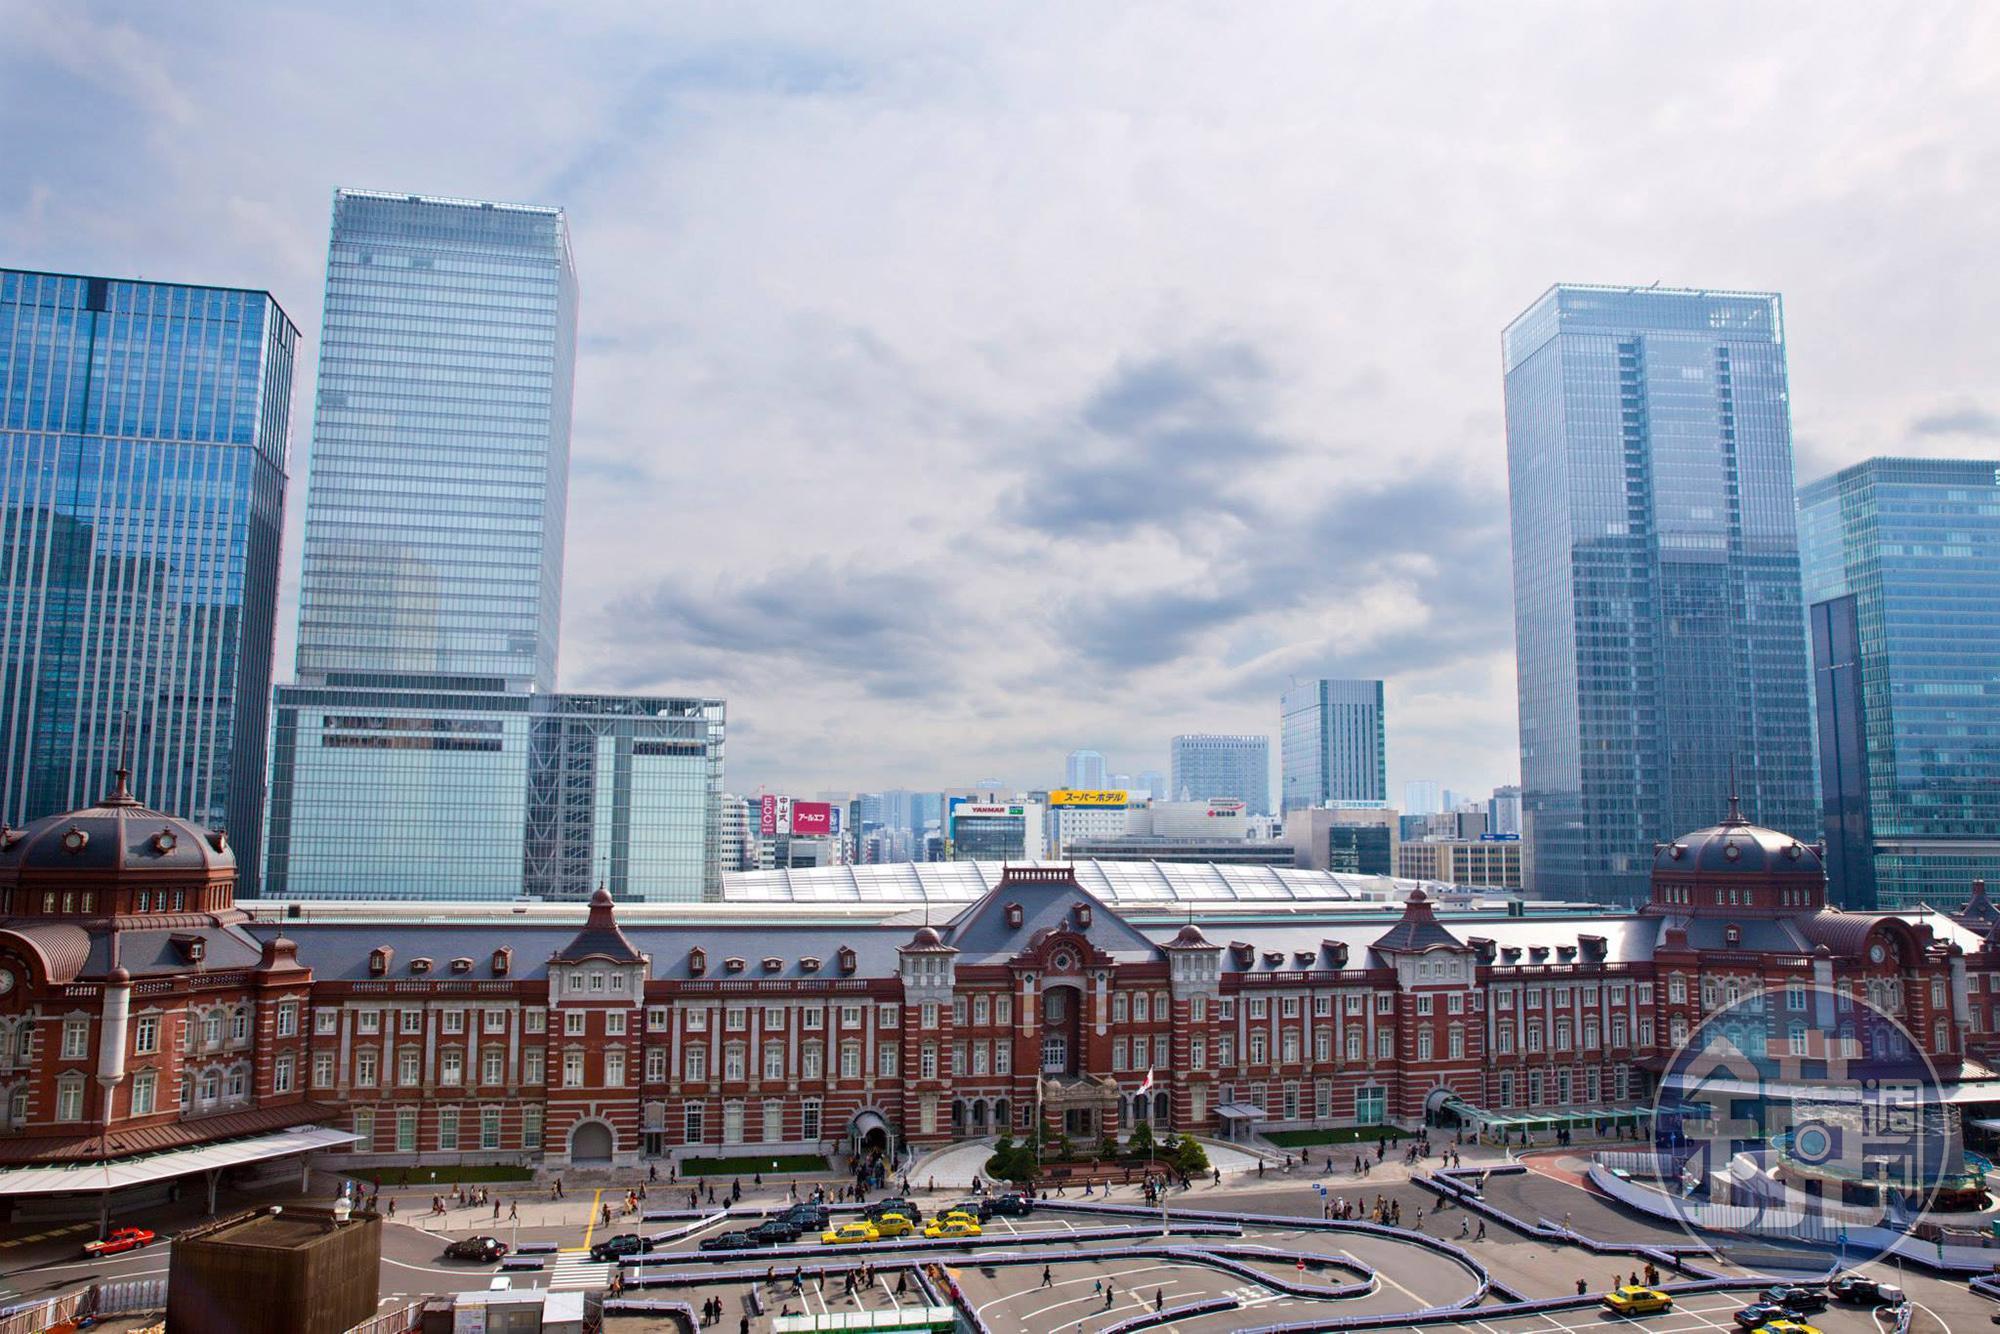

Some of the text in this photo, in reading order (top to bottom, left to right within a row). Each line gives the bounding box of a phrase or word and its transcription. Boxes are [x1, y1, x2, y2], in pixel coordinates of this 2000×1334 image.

[1064, 793, 1124, 802] スーパーホテル
[763, 797, 773, 824] ECC
